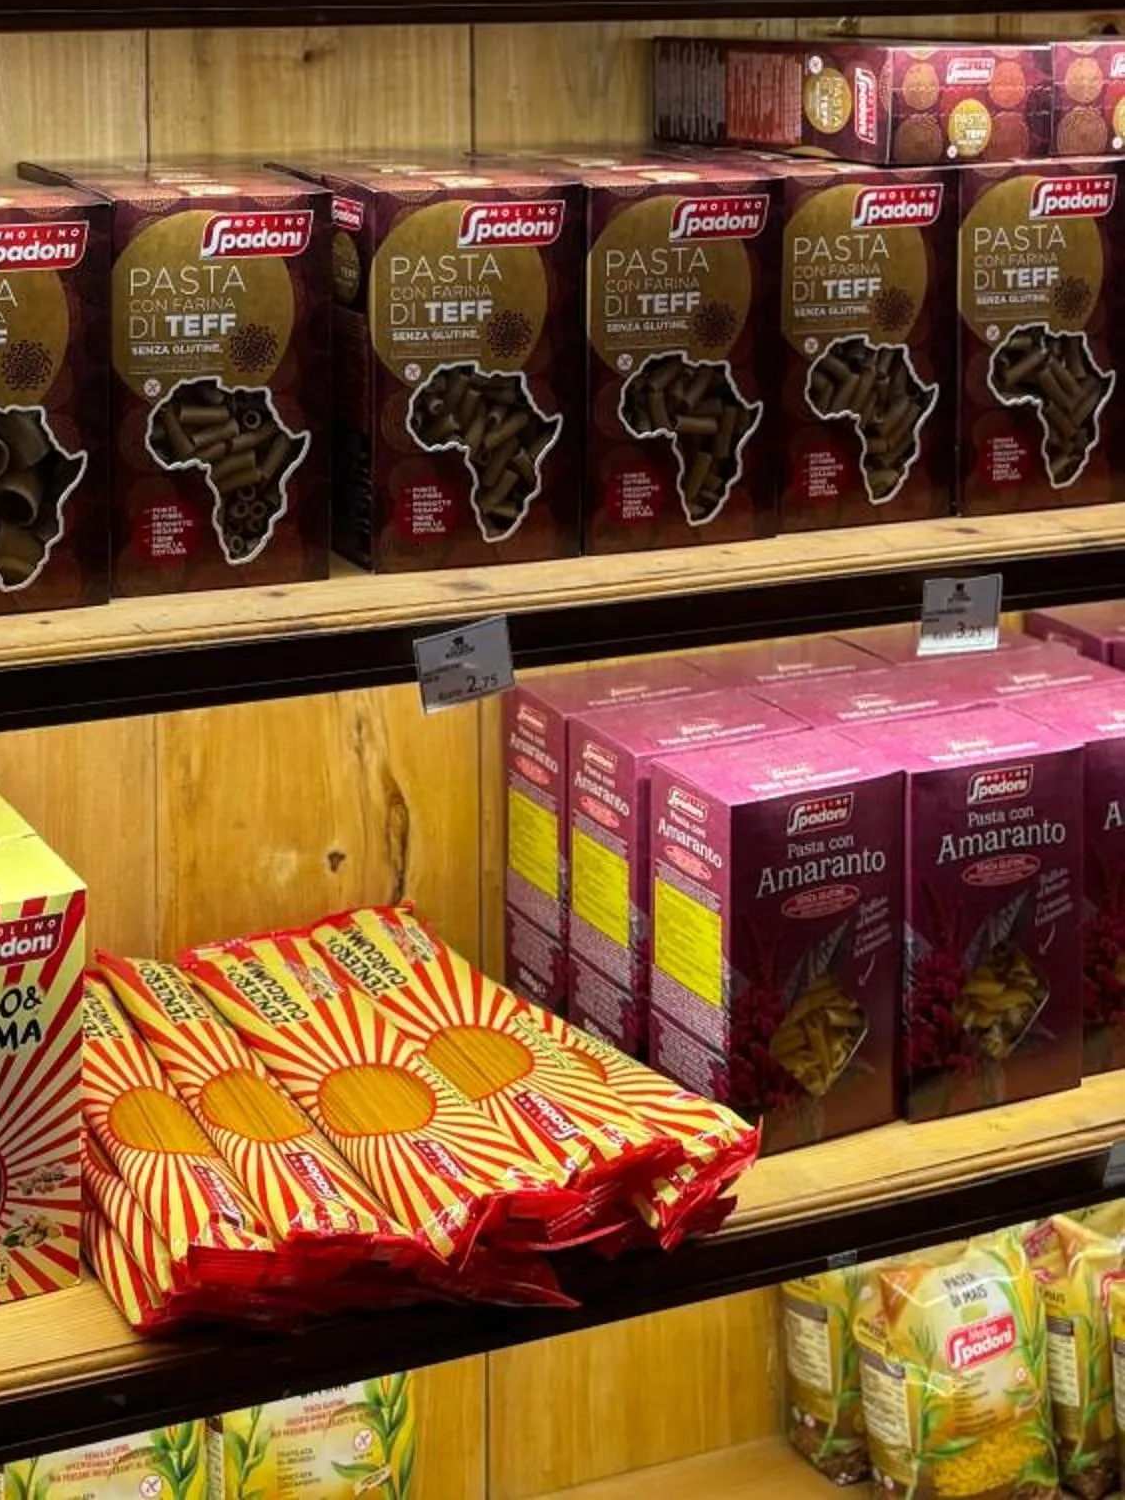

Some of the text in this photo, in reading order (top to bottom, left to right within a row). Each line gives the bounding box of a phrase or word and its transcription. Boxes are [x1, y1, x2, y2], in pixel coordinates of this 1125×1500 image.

[488, 206, 558, 218] MOLINO
[698, 200, 762, 212] MOLINO
[851, 191, 935, 228] Spadoni
[1029, 183, 1109, 220] Spadoni
[4, 228, 80, 240] MOLINO
[232, 216, 305, 228] MOLINO
[457, 209, 555, 247] Spadoni
[669, 203, 759, 241] Spadoni
[200, 219, 302, 258] Spadoni
[793, 232, 891, 263] PASTA
[974, 223, 1068, 253] PASTA
[390, 252, 503, 285] PASTA
[605, 246, 711, 278] PASTA
[130, 264, 248, 297] PASTA
[792, 277, 882, 302] DI TEFF
[974, 266, 1060, 290] DI TEFF
[390, 299, 494, 326] DI TEFF
[605, 291, 702, 317] DI TEFF
[130, 313, 237, 340] DI TEFF
[968, 804, 1035, 828] Pasta con
[657, 817, 723, 869] Amaranto
[787, 834, 855, 859] Pasta con
[937, 820, 1067, 864] Amaranto
[756, 847, 887, 899] Amaranto
[243, 959, 309, 1021] CURCUMA
[951, 1327, 1013, 1368] Spadoni
